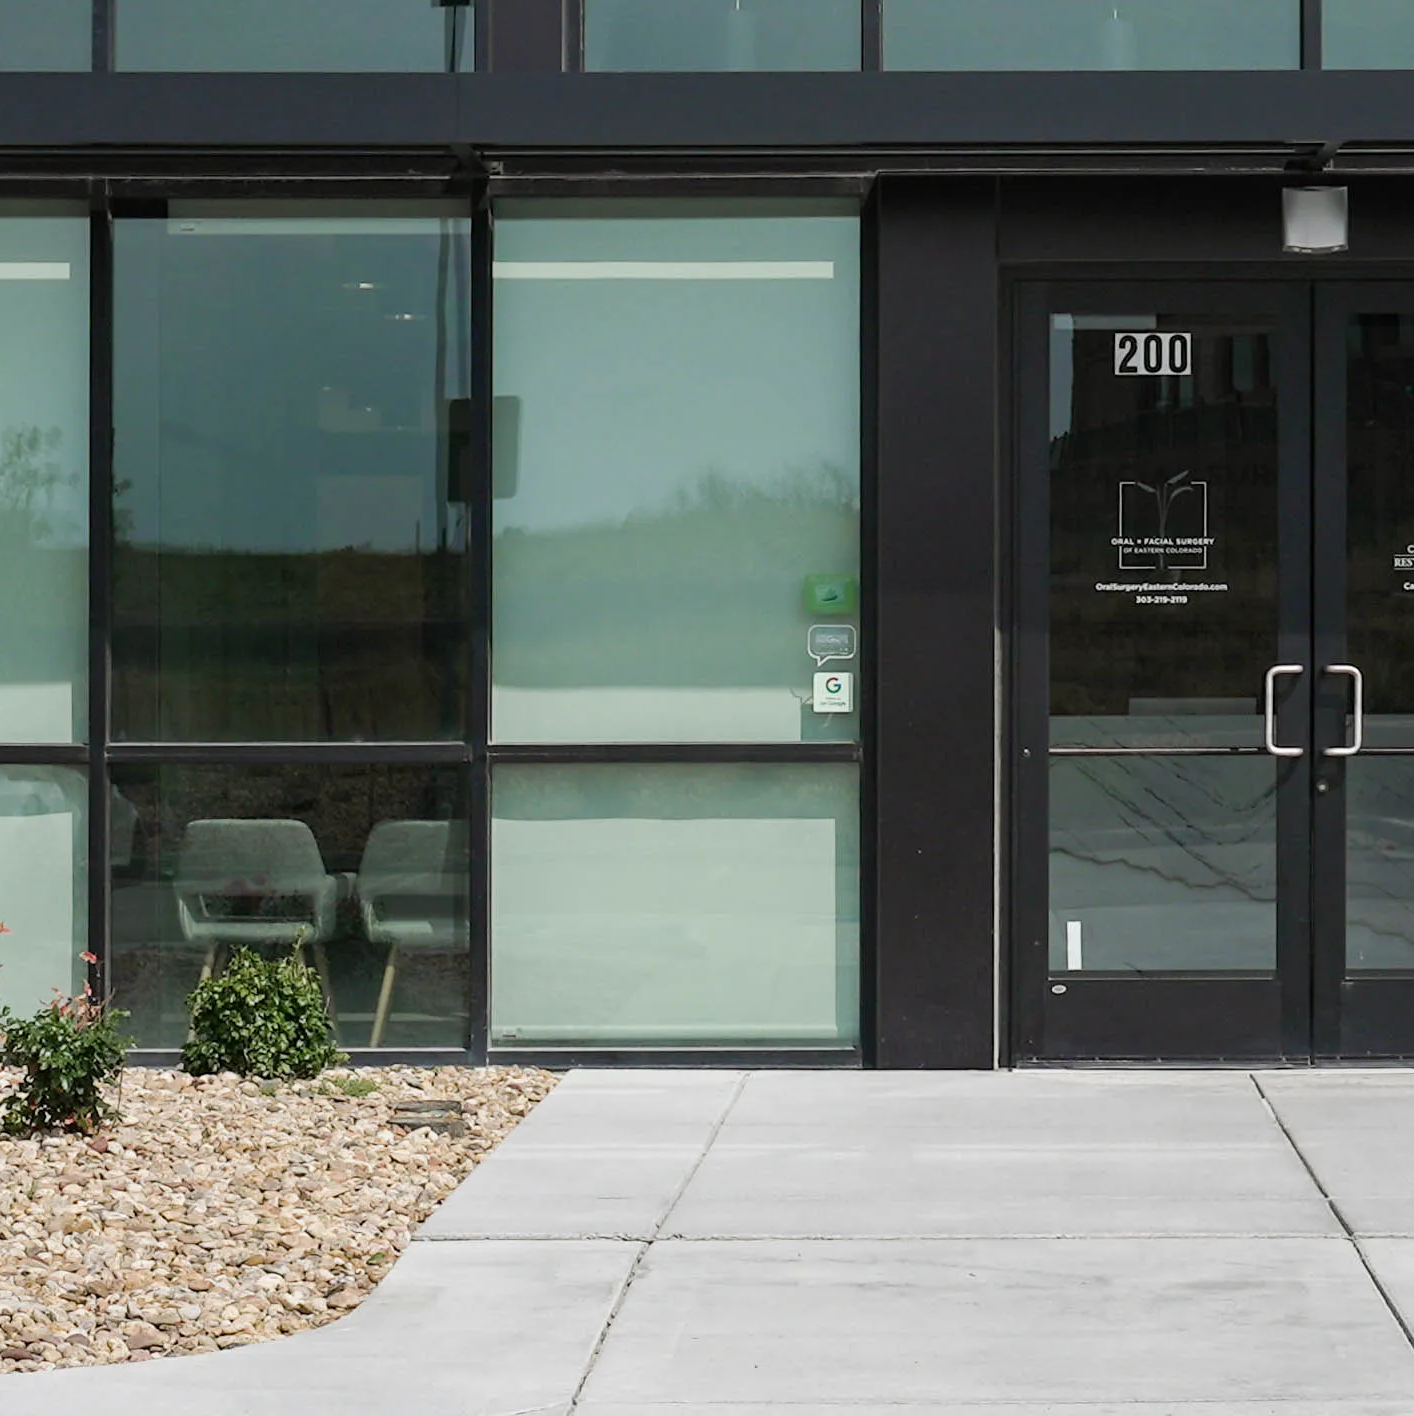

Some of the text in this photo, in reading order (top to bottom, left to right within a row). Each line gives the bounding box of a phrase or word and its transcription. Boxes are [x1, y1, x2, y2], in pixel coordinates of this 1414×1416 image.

[1118, 334, 1188, 374] 200
[1110, 537, 1215, 546] ORAL FACIAL SURGERY
[825, 677, 842, 694] G
